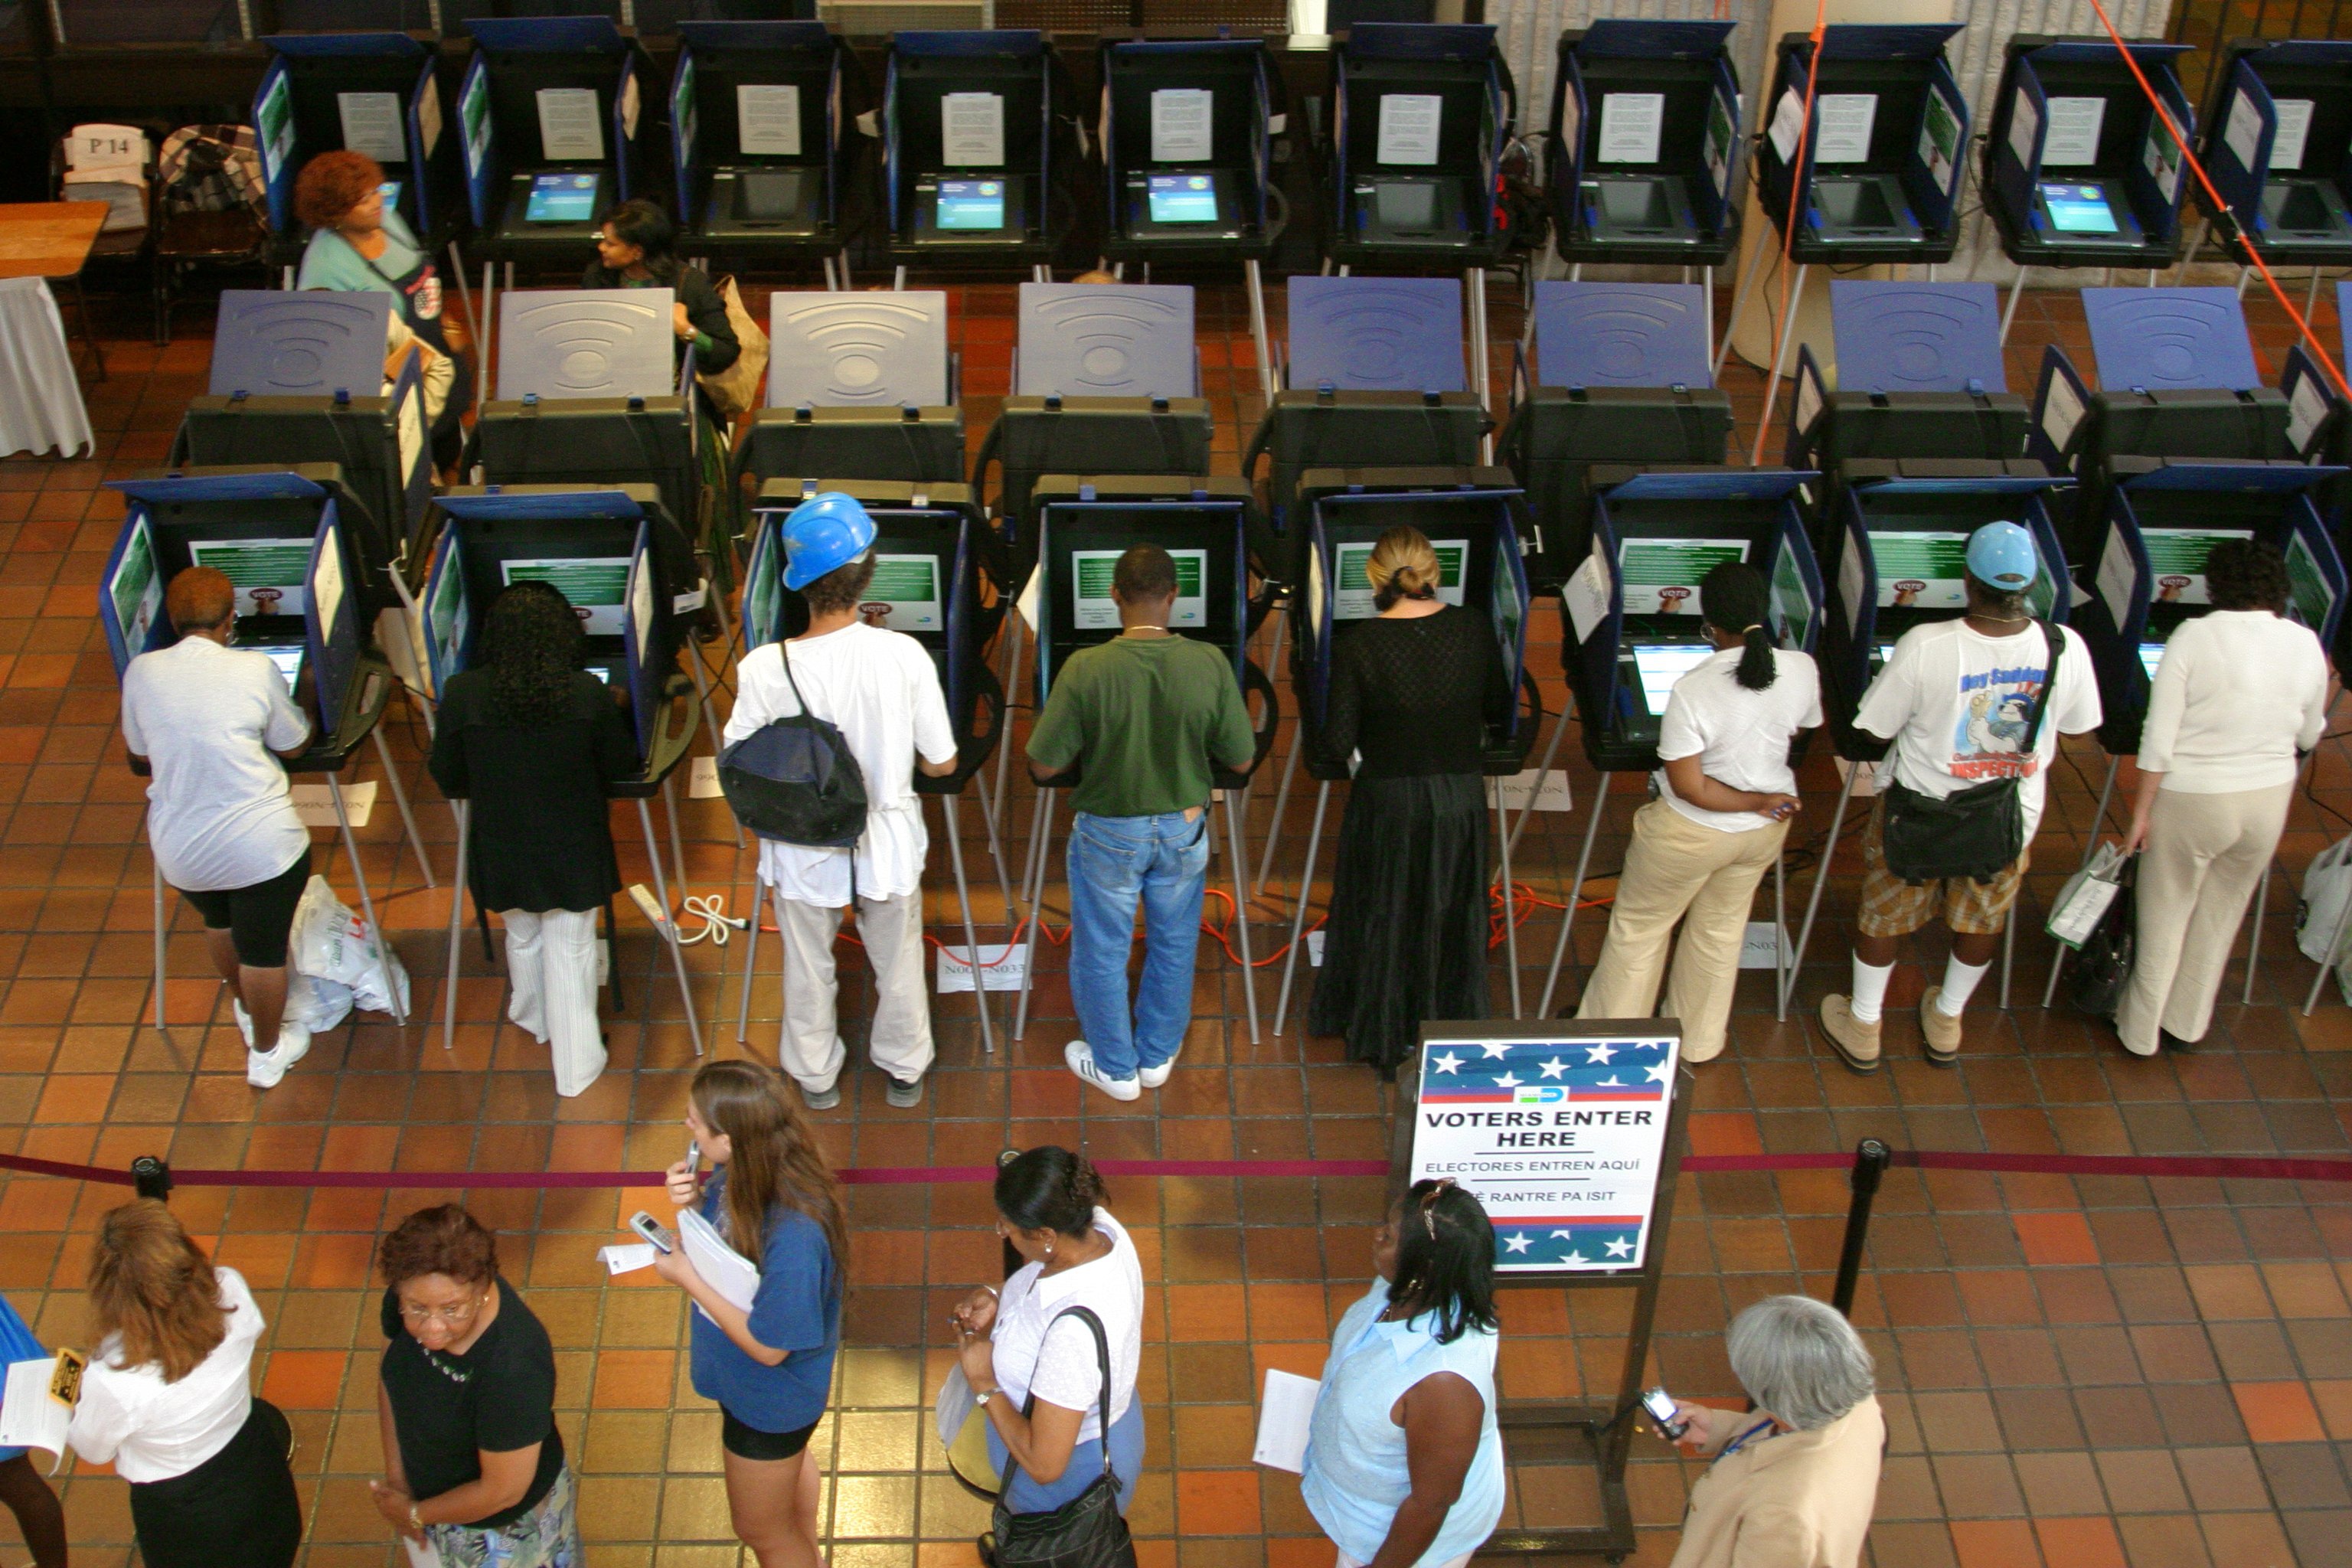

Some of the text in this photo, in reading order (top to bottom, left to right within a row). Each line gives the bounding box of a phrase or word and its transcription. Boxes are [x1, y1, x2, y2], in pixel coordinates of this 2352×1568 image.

[90, 138, 129, 154] P 14
[1426, 1111, 1652, 1128] VOTERS ENTER
[1497, 1132, 1576, 1148] HERE
[1426, 1158, 1641, 1173] ELECTORES ENTREN AQUÍ
[1490, 1192, 1557, 1202] RANTRE
[1561, 1192, 1582, 1201] PA
[1586, 1191, 1616, 1200] ISIT
